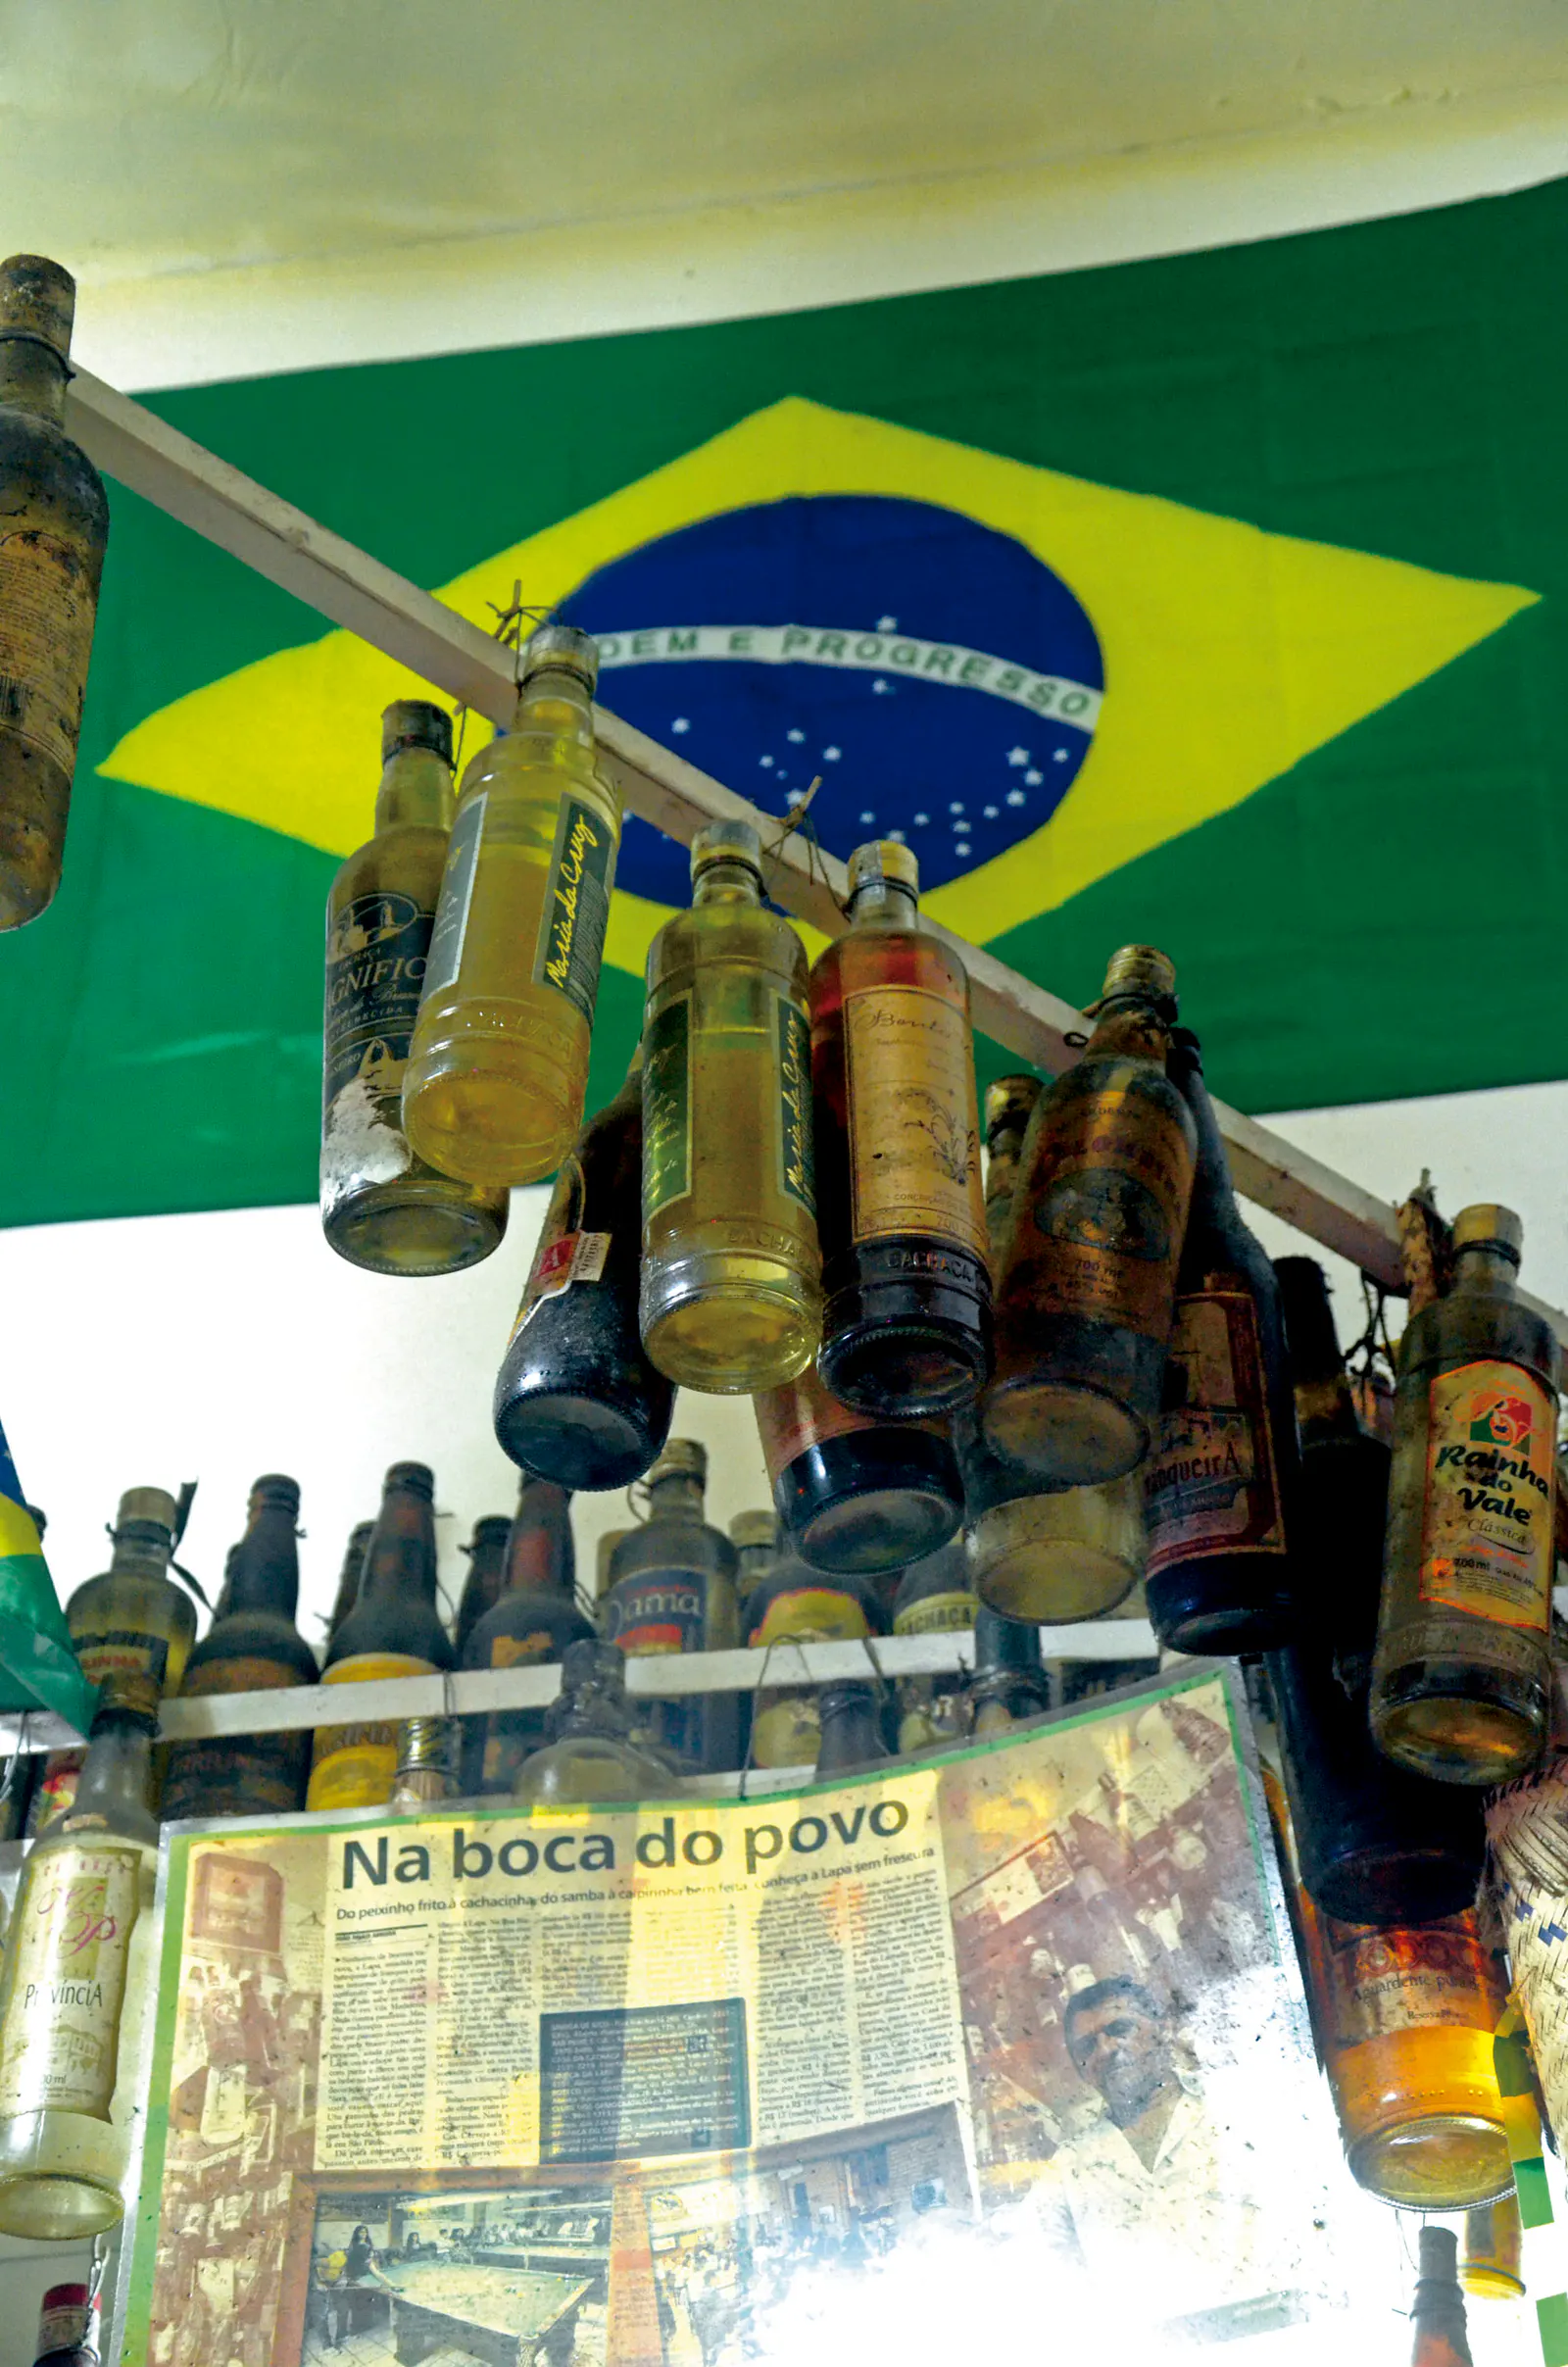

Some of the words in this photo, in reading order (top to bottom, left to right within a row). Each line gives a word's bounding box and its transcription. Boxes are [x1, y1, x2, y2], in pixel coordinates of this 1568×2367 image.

[598, 631, 699, 659] DEM
[728, 629, 756, 654] E
[781, 628, 1091, 717] PROGRESSO
[554, 887, 578, 921] da
[1435, 1444, 1549, 1501] Rainha
[1479, 1470, 1512, 1494] do
[1456, 1486, 1533, 1527] Vale
[343, 1835, 430, 1890] Na
[453, 1827, 616, 1880] boca
[636, 1816, 723, 1869] do
[744, 1800, 909, 1874] povo
[336, 1907, 357, 1921] Do
[359, 1901, 415, 1921] peixinho
[417, 1898, 447, 1913] frito
[540, 1891, 559, 1904] do
[561, 1889, 606, 1903] samba
[821, 1864, 853, 1882] Lapa
[856, 1859, 882, 1876] sem
[24, 1979, 104, 2009] PrvínciA
